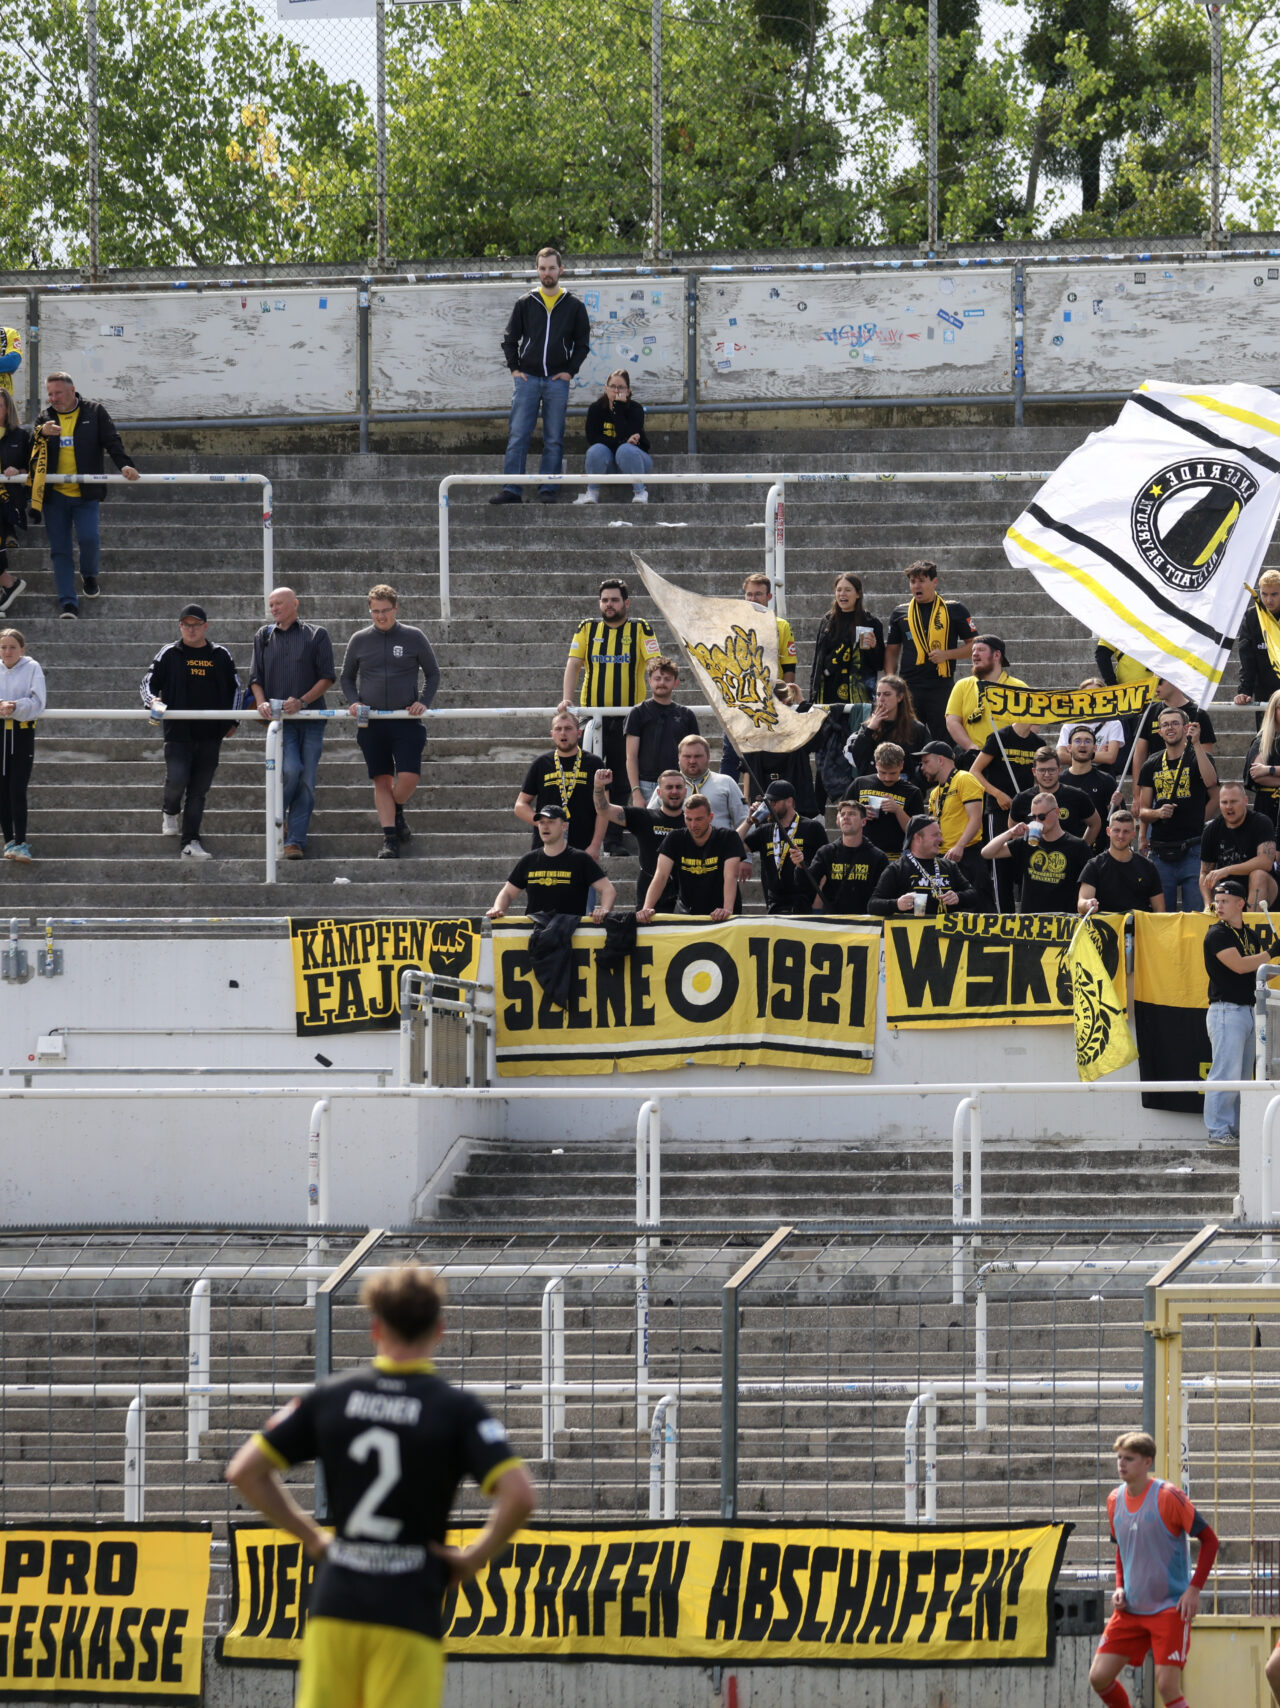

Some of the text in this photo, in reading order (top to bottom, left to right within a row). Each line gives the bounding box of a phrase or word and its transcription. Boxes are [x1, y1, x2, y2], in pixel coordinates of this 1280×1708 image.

[591, 653, 630, 664] maxit
[985, 684, 1147, 717] SUPCREW
[301, 919, 430, 971] KÄMPFEN
[942, 911, 1078, 941] SUPCREW
[748, 936, 870, 1028] 1921
[891, 924, 1051, 1008] WSK
[346, 1425, 403, 1541] 2
[1, 1540, 138, 1596] PRO
[705, 1540, 1033, 1643] ABSCHAFFEN!
